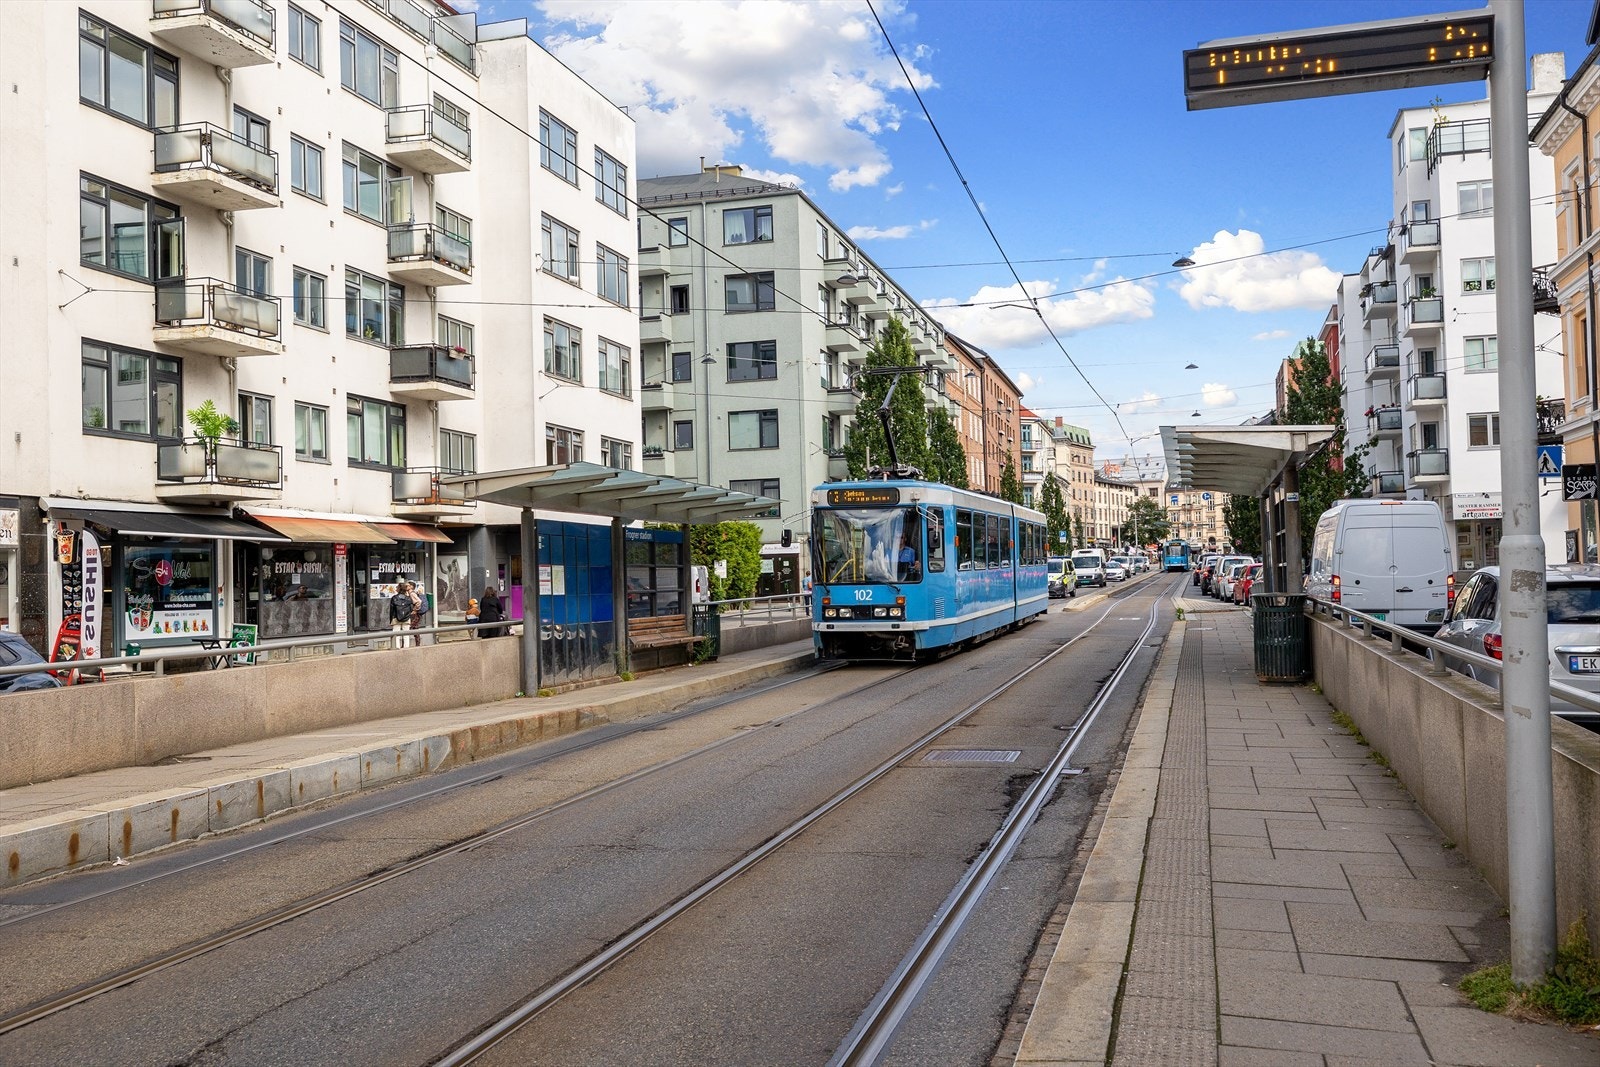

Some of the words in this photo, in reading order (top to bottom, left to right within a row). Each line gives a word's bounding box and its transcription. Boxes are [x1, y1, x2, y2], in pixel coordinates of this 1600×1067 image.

[275, 561, 296, 574] ESTAR
[303, 561, 323, 574] SUSHI
[379, 562, 395, 573] ESTAR
[401, 562, 417, 573] SUSHI
[853, 589, 873, 601] 102
[1582, 658, 1598, 669] EK
